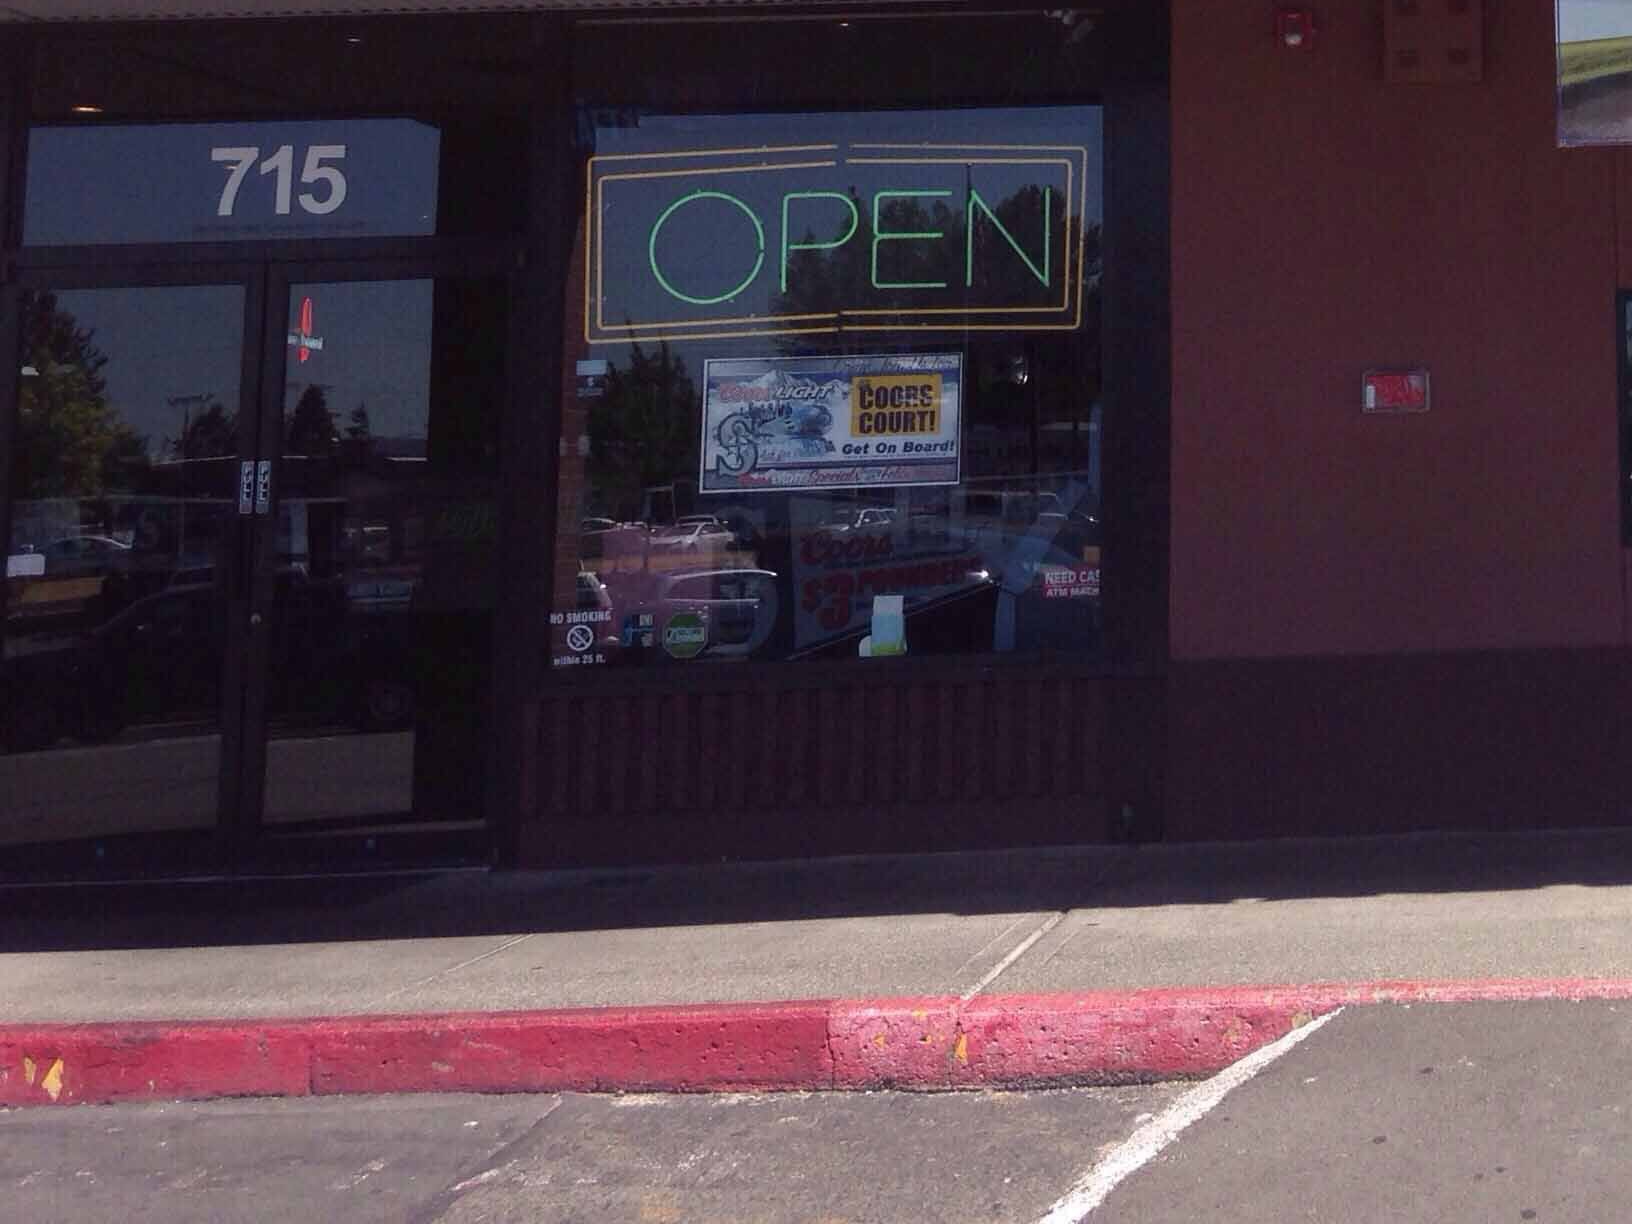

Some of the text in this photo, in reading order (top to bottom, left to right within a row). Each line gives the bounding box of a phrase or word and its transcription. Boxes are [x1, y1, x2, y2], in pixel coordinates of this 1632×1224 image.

[210, 145, 348, 216] 715
[648, 187, 1052, 304] OPEN
[775, 383, 834, 399] LIGHT
[859, 410, 936, 434] COURT!
[842, 443, 869, 456] Get
[875, 442, 897, 454] On
[903, 440, 955, 453] Board!
[1045, 571, 1077, 585] NEED
[550, 610, 612, 624] NO SMOKING
[582, 654, 594, 664] 25
